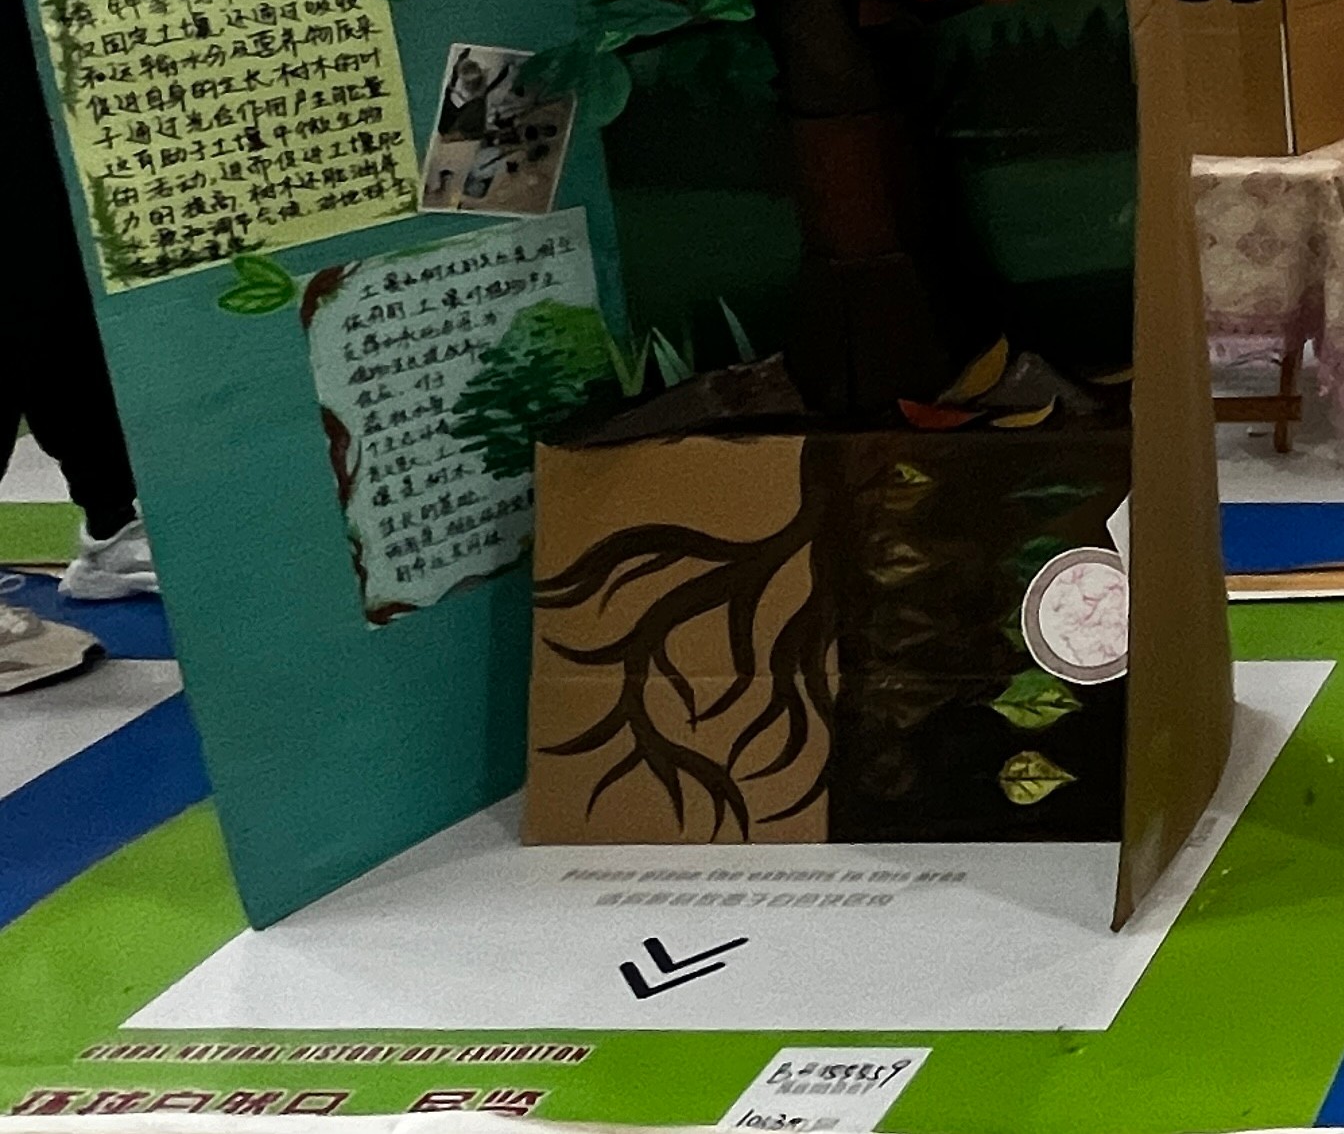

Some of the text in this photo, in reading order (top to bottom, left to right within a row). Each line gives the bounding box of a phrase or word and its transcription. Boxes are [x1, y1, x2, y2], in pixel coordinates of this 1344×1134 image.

[79, 1045, 167, 1062] GLOBAL
[175, 1045, 284, 1062] NATURAL
[286, 1045, 397, 1063] HISTORY
